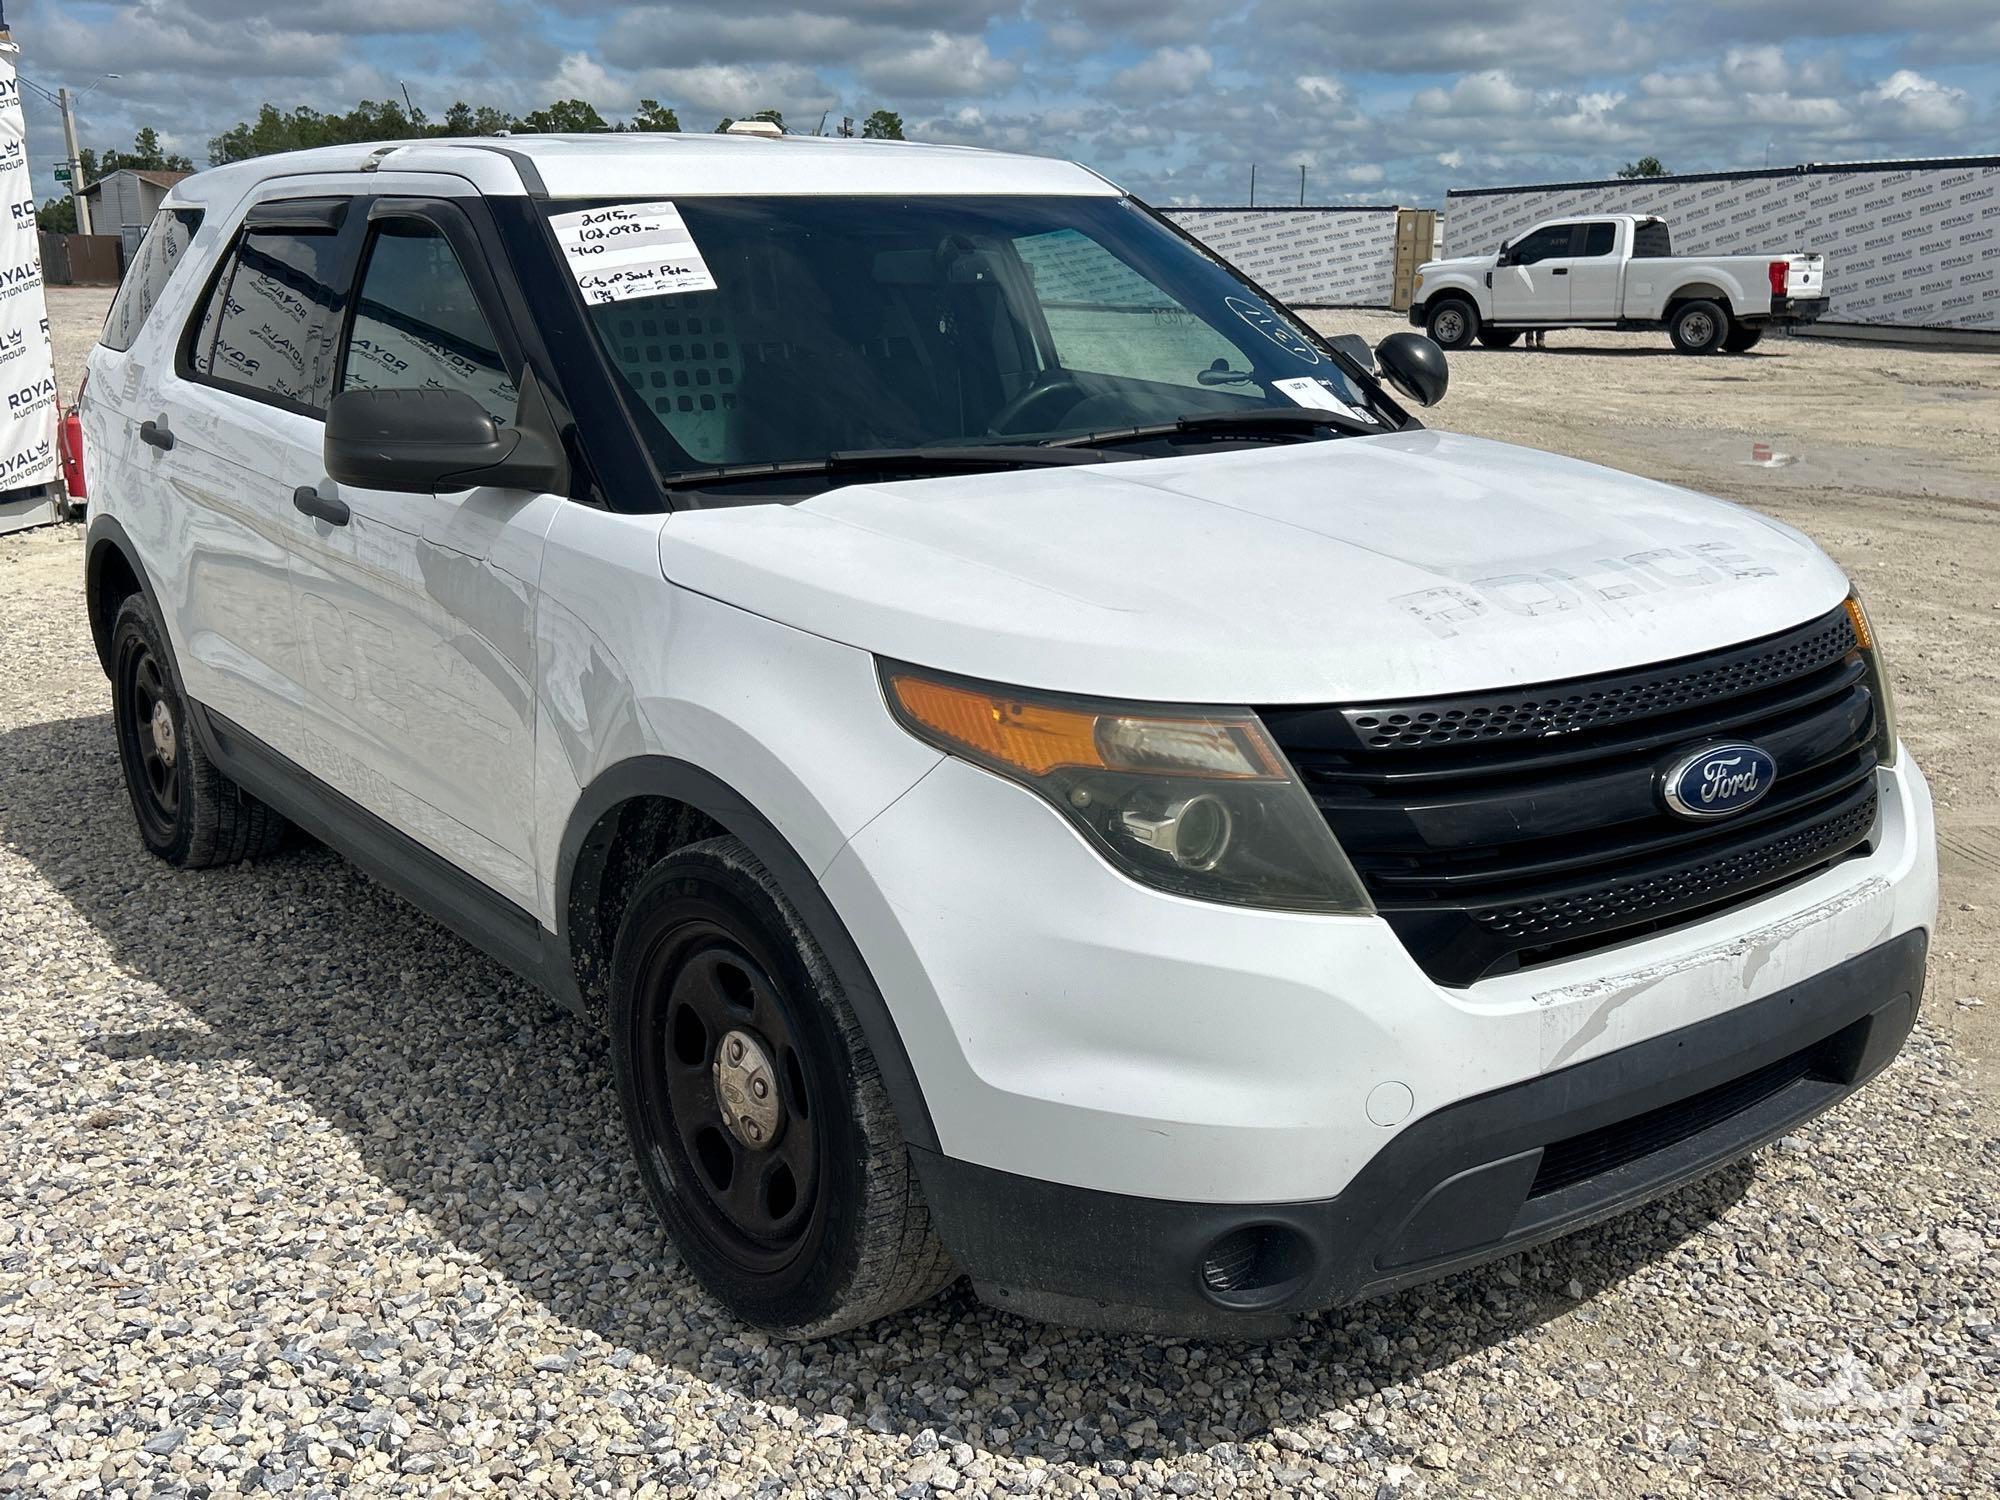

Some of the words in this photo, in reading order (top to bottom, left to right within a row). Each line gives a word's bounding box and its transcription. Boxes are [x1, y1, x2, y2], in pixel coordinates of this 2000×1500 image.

[0, 159, 24, 172] ROUP
[1882, 173, 1905, 184] ROYAL
[1941, 174, 1965, 186] ROYAL
[1845, 185, 1867, 195] ROYAL
[1902, 187, 1925, 198] ROYAL
[1960, 189, 1984, 201] ROYAL
[1811, 196, 1831, 206] ROYAL
[1865, 198, 1886, 208] ROYAL
[1920, 201, 1943, 212] ROYAL
[1829, 209, 1850, 219] ROYAL
[1882, 213, 1904, 223] ROYAL
[1941, 215, 1965, 226] ROYAL
[1845, 223, 1867, 233] ROYAL
[1902, 226, 1924, 237] ROYAL
[1811, 233, 1831, 243] ROYAL
[1960, 230, 1984, 242] ROYAL
[1865, 237, 1886, 247] ROYAL
[1920, 241, 1943, 252] ROYAL
[1829, 247, 1850, 256] ROYAL
[1882, 251, 1904, 262] ROYAL
[1846, 261, 1867, 271] ROYAL
[1941, 256, 1965, 267] ROYAL
[1903, 266, 1924, 276] ROYAL
[1960, 271, 1984, 282] ROYAL
[1865, 275, 1887, 285] ROYAL
[1830, 284, 1850, 294] ROYAL
[1921, 281, 1944, 292] ROYAL
[1883, 290, 1905, 301] ROYAL
[1846, 299, 1868, 309] ROYAL
[1942, 296, 1965, 307] ROYAL
[1903, 305, 1926, 316] ROYAL
[1961, 312, 1985, 323] ROYAL
[8, 378, 55, 410] ROYA
[14, 397, 50, 420] AUCTION
[25, 456, 54, 476] GROUP
[1701, 756, 1758, 803] Ford
